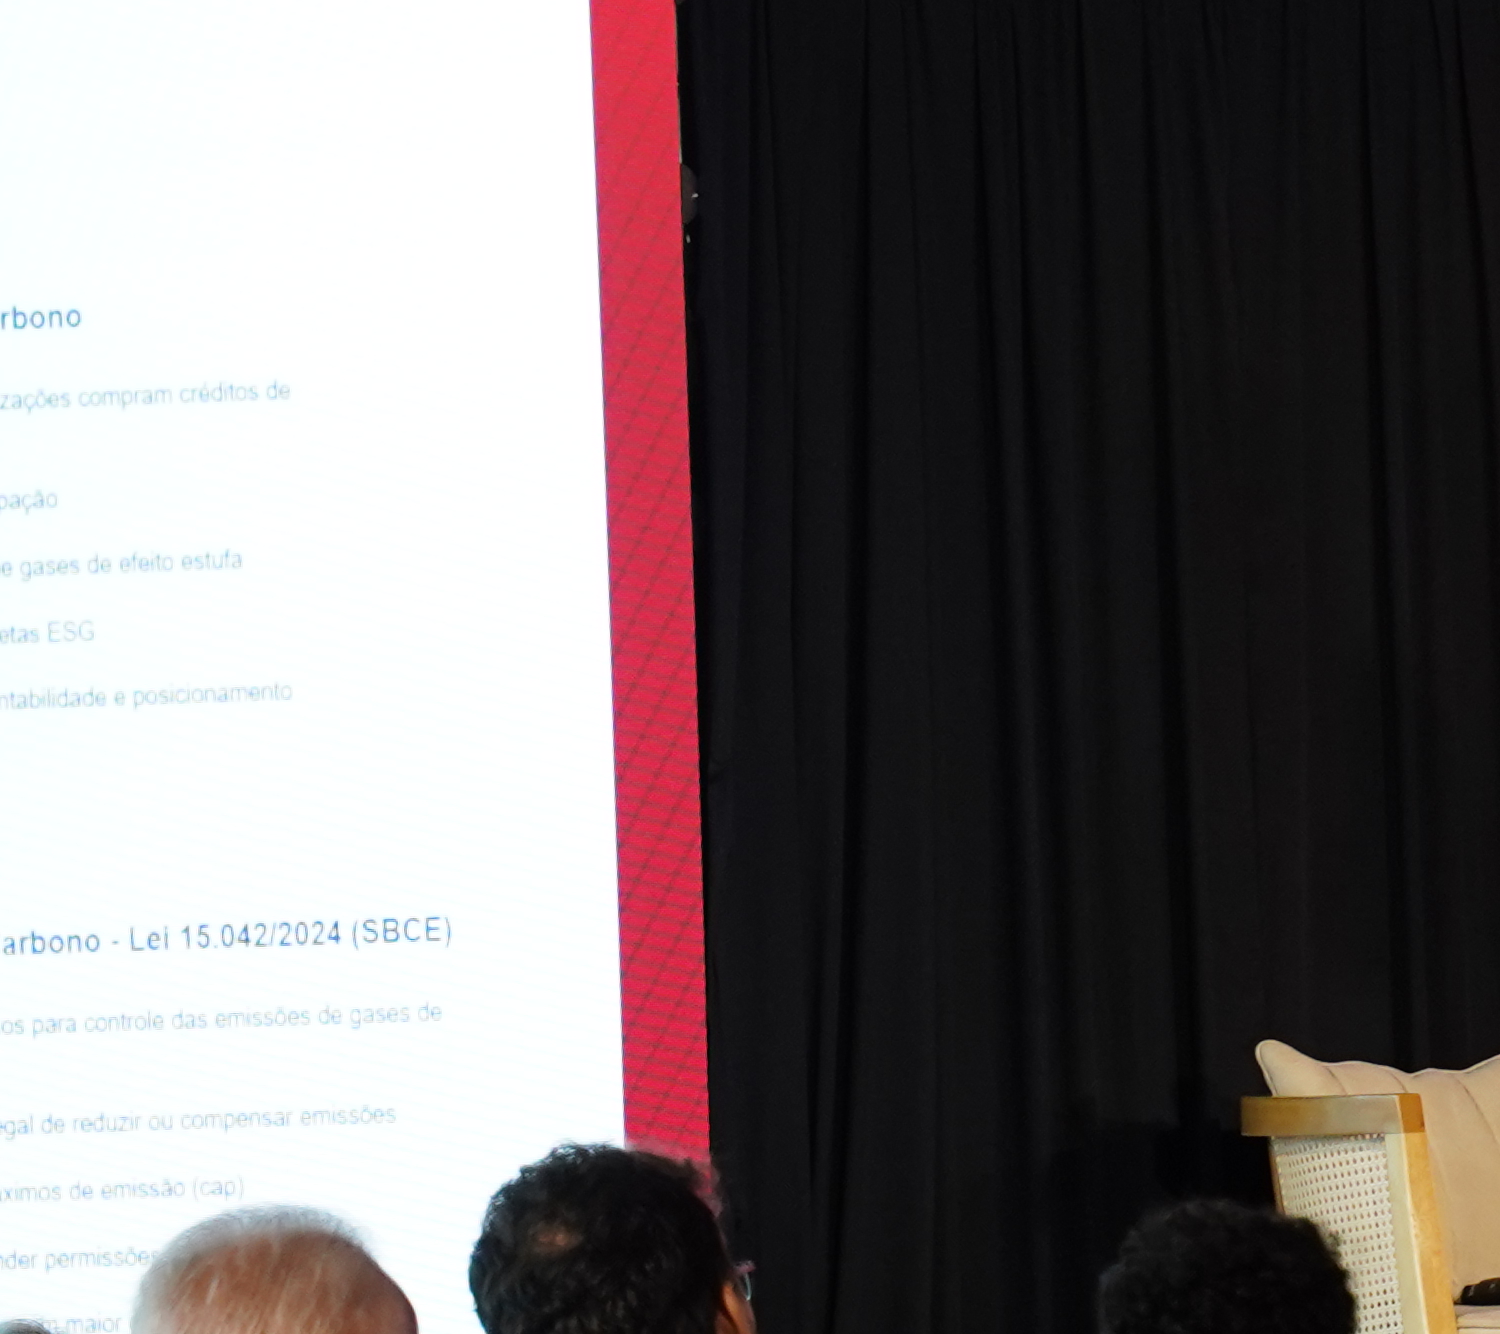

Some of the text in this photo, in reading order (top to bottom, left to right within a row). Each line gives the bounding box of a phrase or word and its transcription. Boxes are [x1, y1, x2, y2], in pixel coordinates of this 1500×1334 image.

[179, 381, 260, 403] créditos
[266, 379, 291, 401] de
[87, 553, 112, 574] de
[47, 619, 95, 643] ESG
[129, 925, 169, 952] Lei
[180, 919, 342, 949] 15.042/2024
[351, 914, 452, 950] (SBCE)
[32, 1016, 77, 1039] para
[84, 1009, 164, 1033] controle
[171, 1010, 208, 1030] das
[214, 1007, 311, 1029] emissões
[318, 1007, 342, 1025] de
[350, 1005, 410, 1030] gases
[418, 1002, 443, 1022] de
[41, 1113, 65, 1135] de
[72, 1111, 141, 1133] reduzir
[180, 1110, 292, 1133] compensar
[0, 1184, 61, 1202] ximos
[69, 1181, 94, 1200] de
[100, 1177, 186, 1201] emissão
